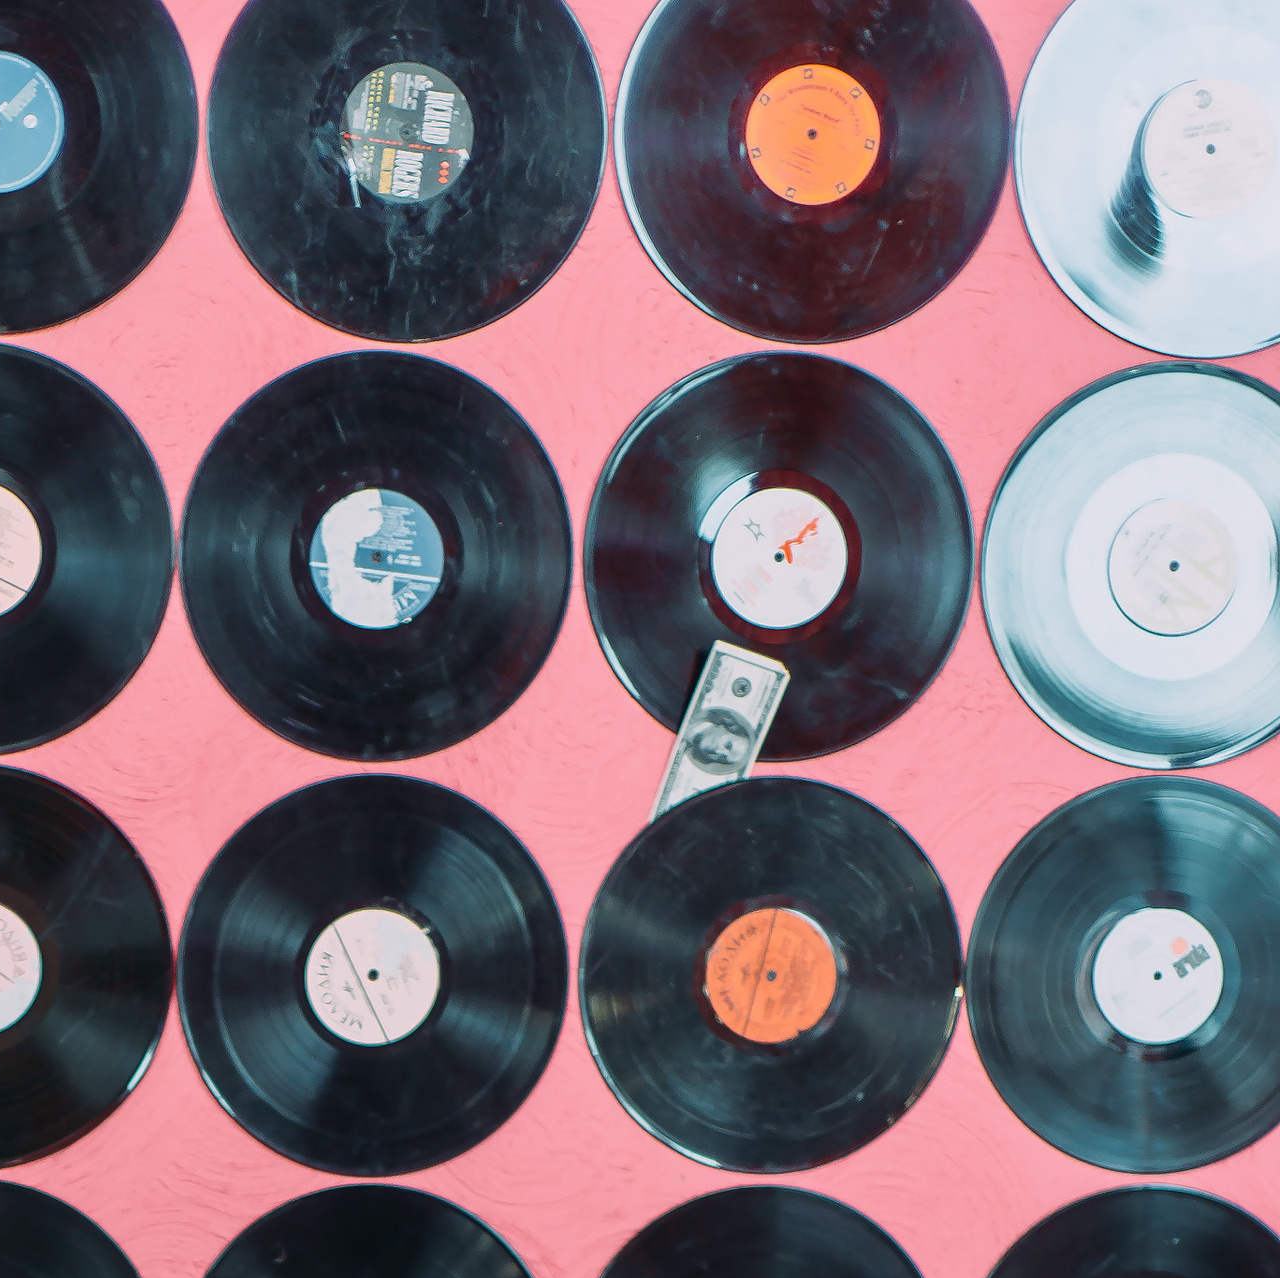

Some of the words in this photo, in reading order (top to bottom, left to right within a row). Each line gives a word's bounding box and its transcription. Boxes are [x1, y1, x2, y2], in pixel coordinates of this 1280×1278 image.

[422, 90, 455, 145] RICHARD
[391, 149, 424, 200] ROGERS
[316, 950, 363, 1031] МЕЛОДИЯ
